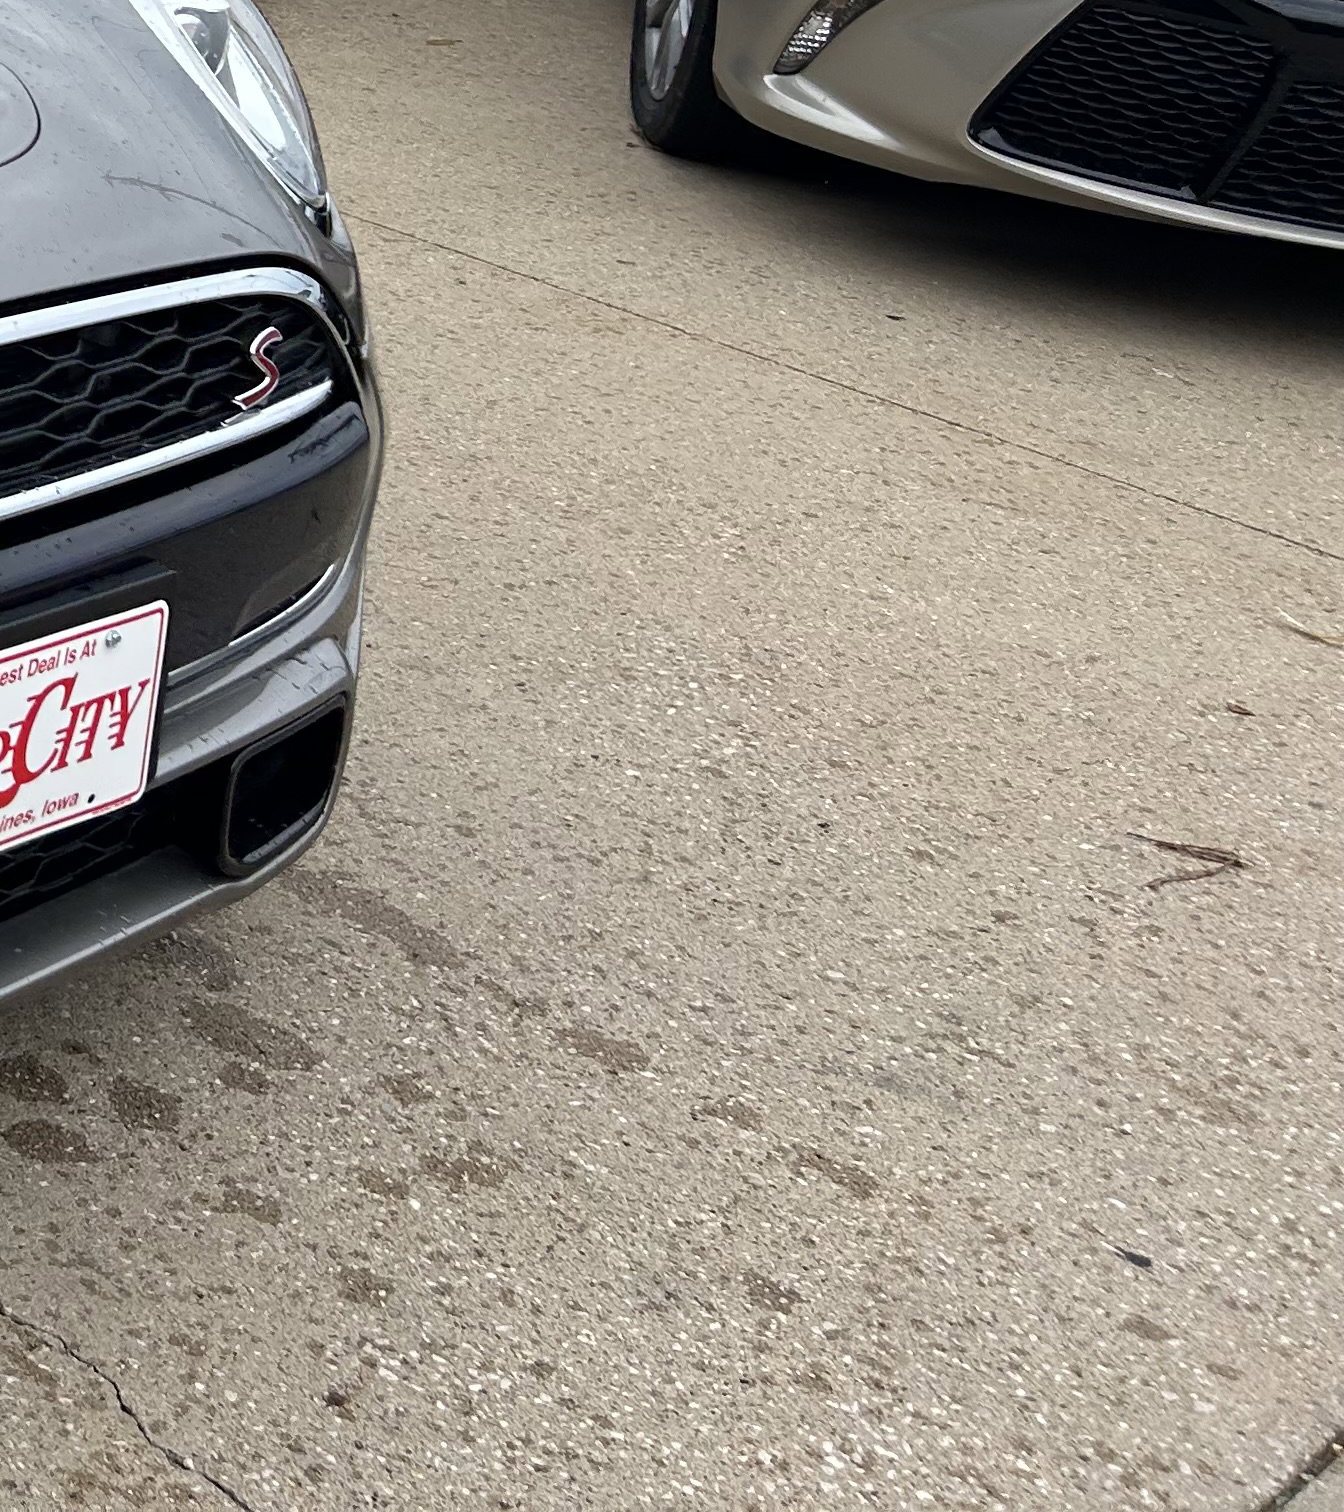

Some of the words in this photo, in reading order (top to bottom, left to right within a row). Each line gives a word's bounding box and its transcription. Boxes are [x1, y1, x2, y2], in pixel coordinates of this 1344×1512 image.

[231, 326, 283, 411] S
[27, 650, 60, 676] Deal
[64, 645, 78, 666] Is
[79, 639, 98, 661] At
[41, 791, 80, 819] Iowa
